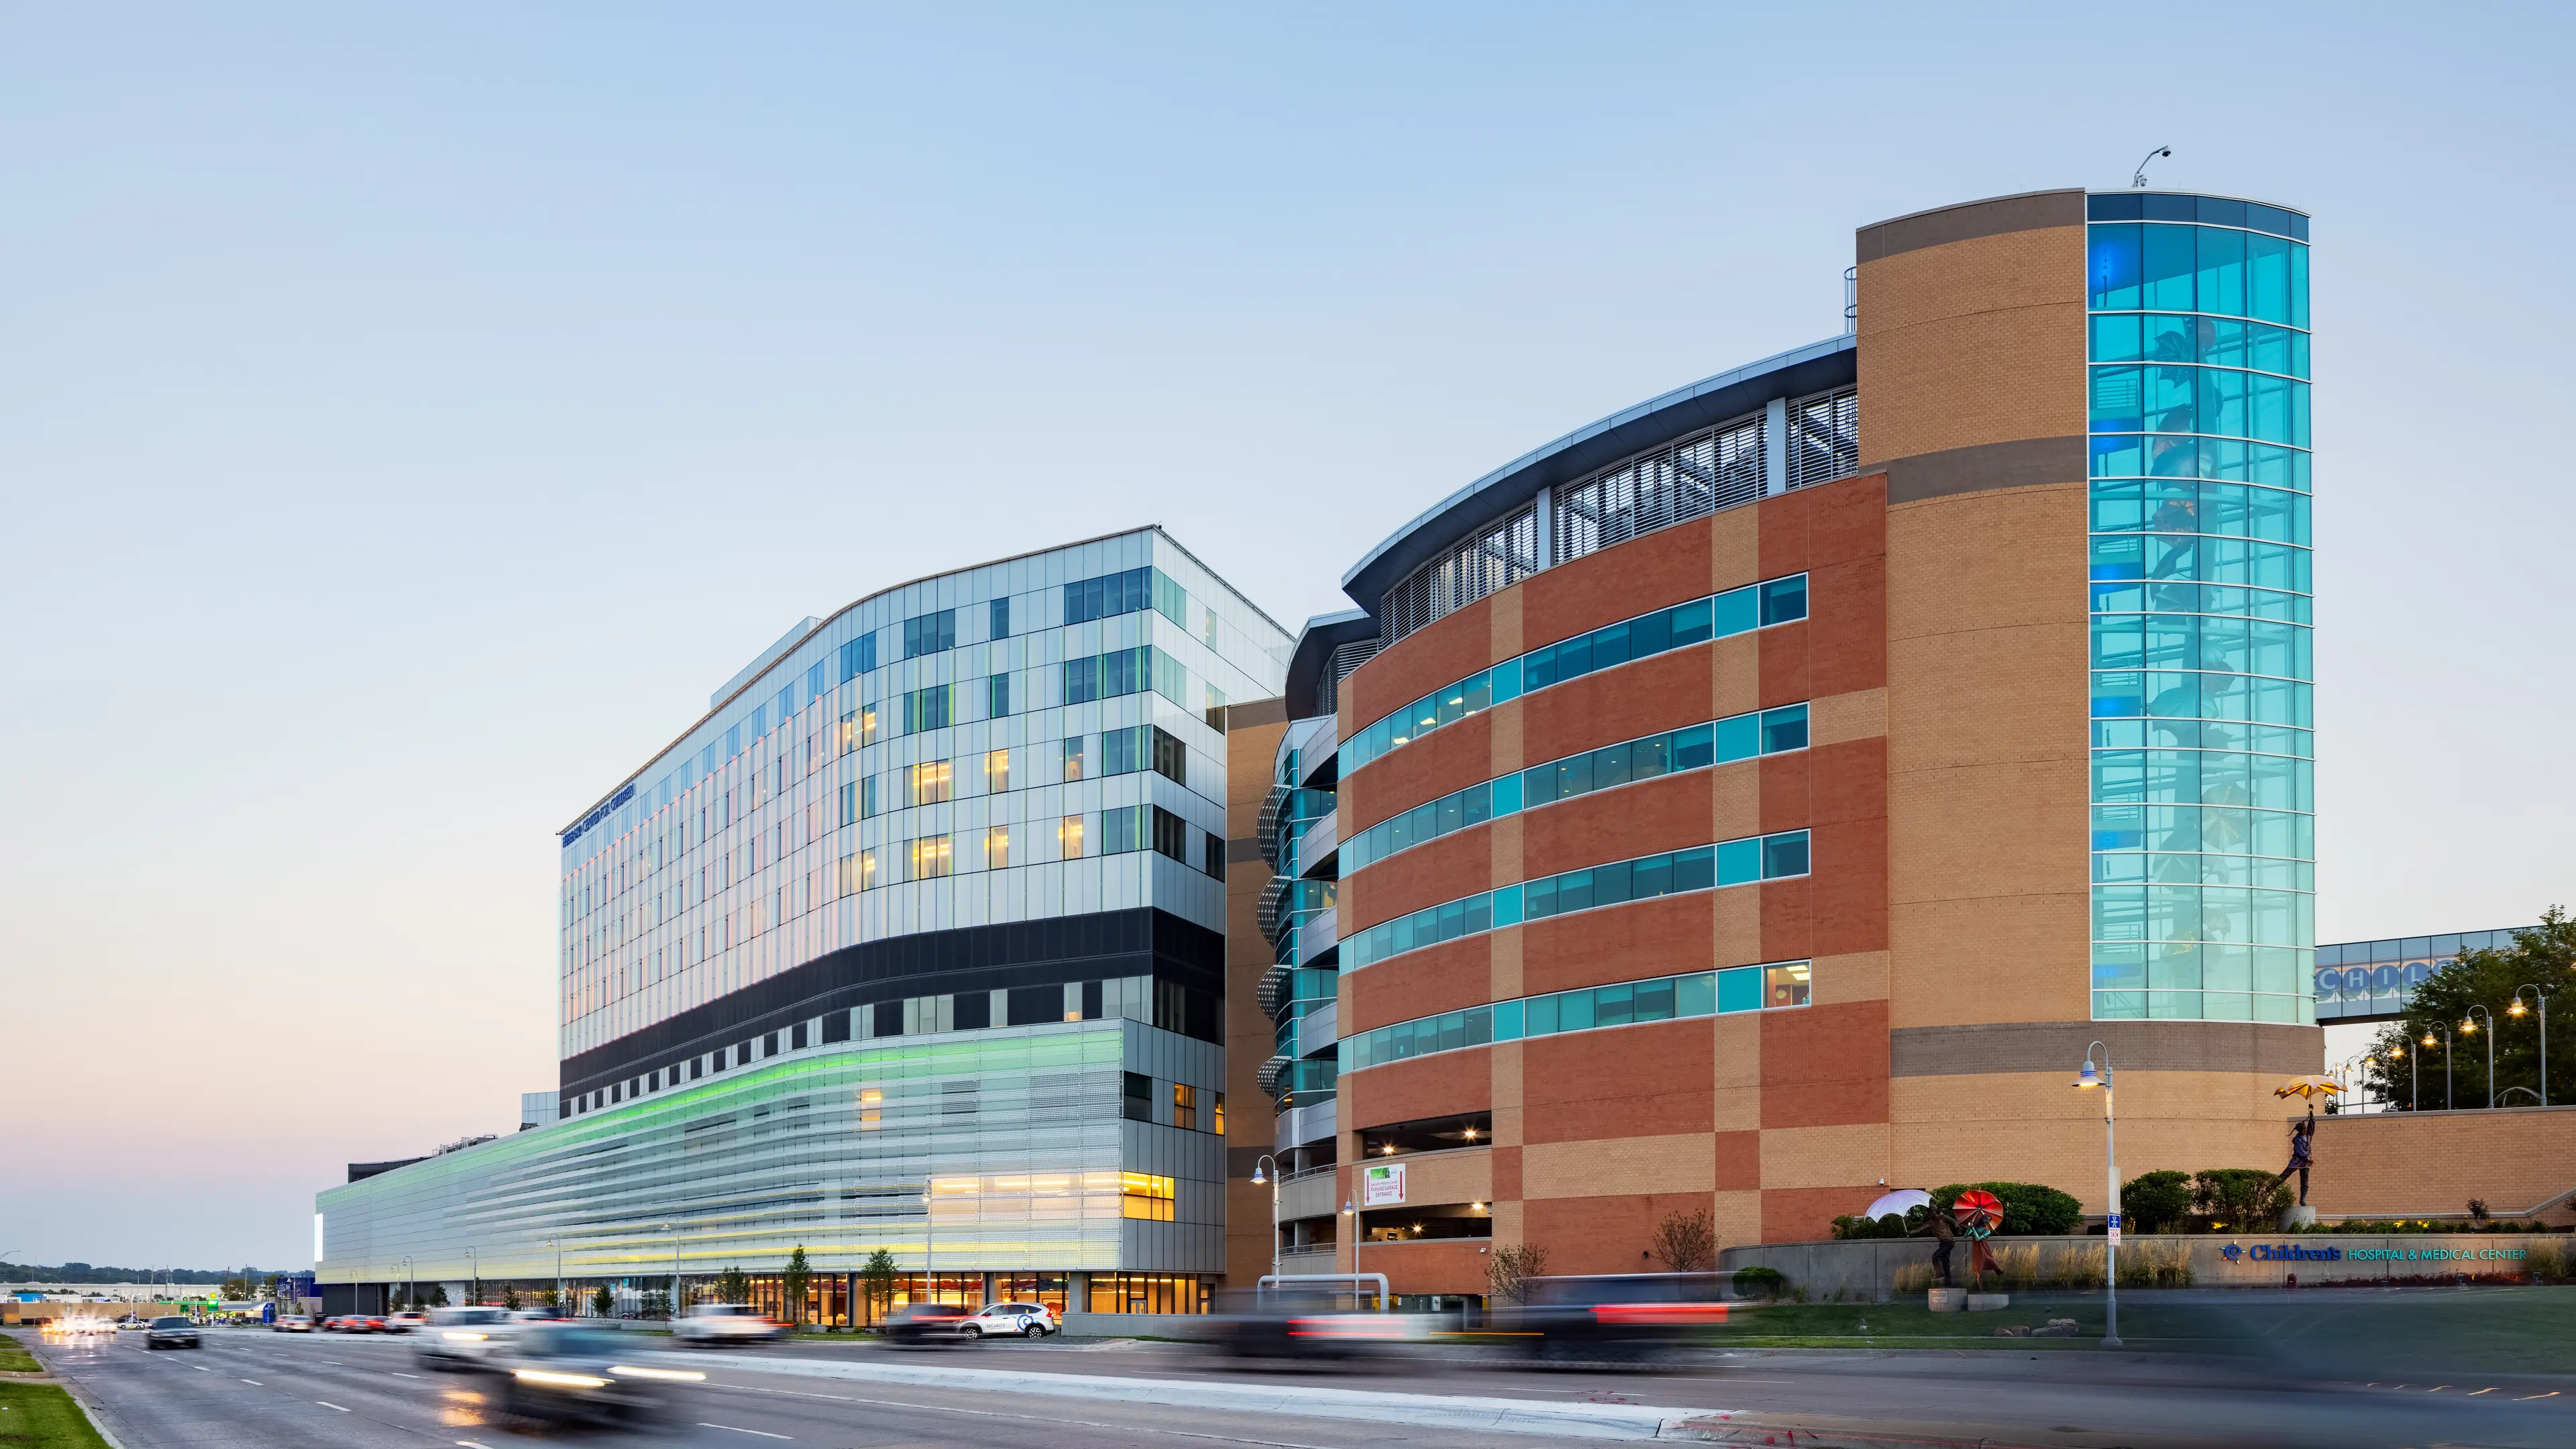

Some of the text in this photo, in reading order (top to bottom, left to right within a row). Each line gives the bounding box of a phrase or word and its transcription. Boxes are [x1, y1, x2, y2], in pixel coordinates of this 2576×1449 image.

[583, 810, 600, 832] CENTER
[610, 783, 635, 811] CHILDREN
[2250, 1243, 2526, 1260] Children's HOSPITAL & MEDICAL CENTER
